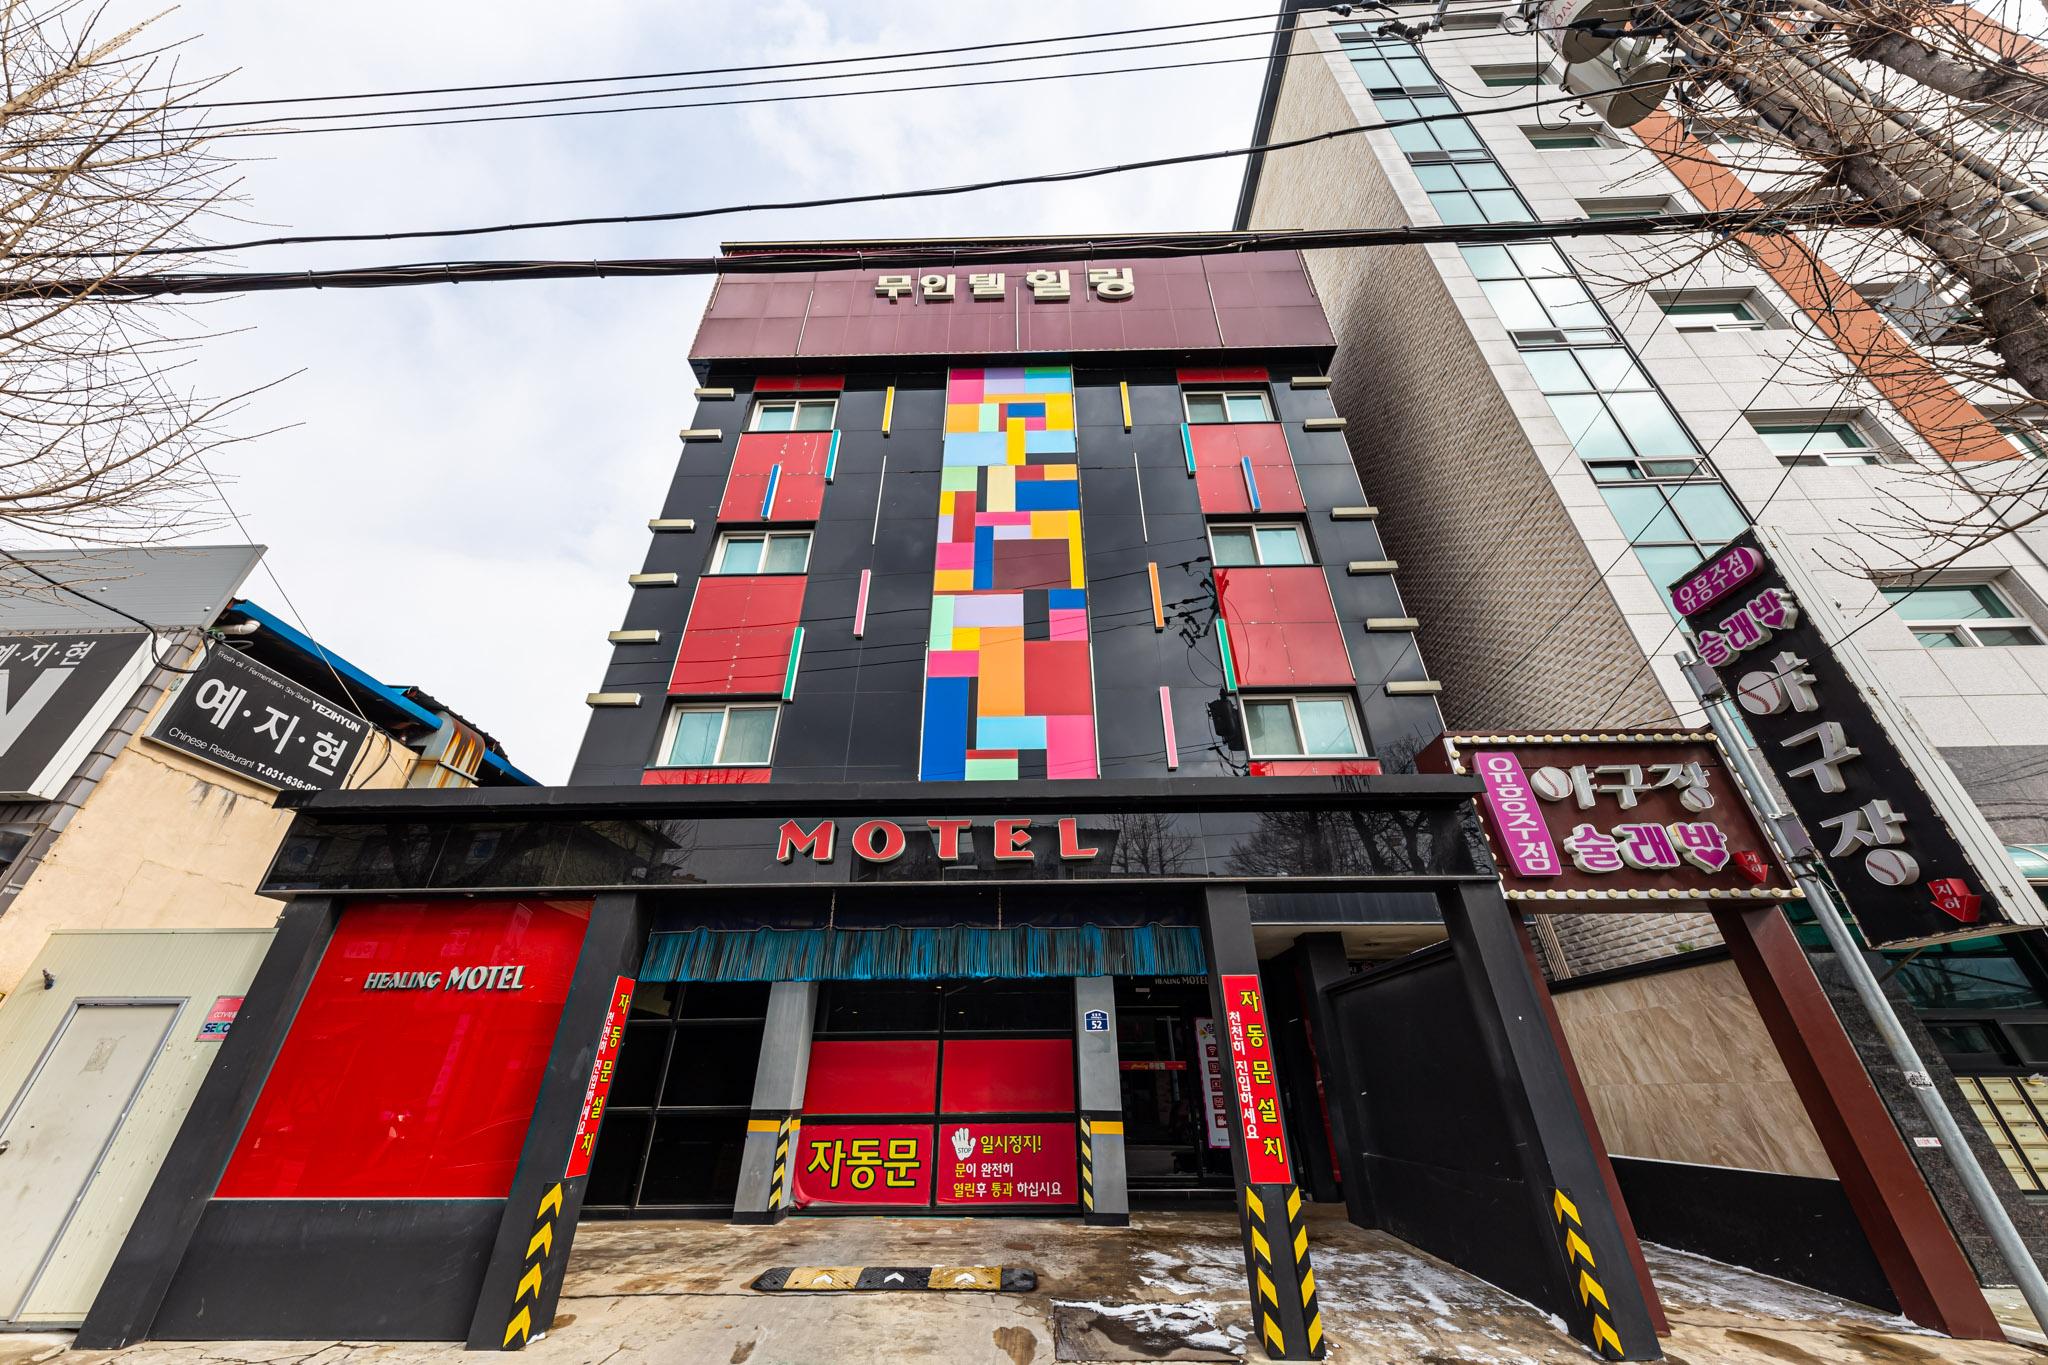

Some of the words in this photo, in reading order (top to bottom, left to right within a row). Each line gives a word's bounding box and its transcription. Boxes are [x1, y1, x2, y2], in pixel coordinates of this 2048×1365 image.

[875, 272, 1005, 304] 무인텔
[1025, 268, 1135, 303] 힐링
[1678, 547, 1746, 611] 유흥주점
[217, 650, 236, 664] Fresh
[248, 666, 284, 690] Fermentation
[311, 700, 361, 733] YEZIHYUN
[168, 727, 208, 749] Chinese
[208, 743, 255, 768] Restaurant
[1487, 757, 1552, 873] 유흥주점
[776, 817, 1099, 863] MOTEL
[1934, 882, 1963, 910] 지하
[363, 971, 442, 990] HEALING
[445, 965, 525, 990] MOTEL
[1091, 1020, 1103, 1029] 52
[1228, 1011, 1246, 1056] 천천히
[1235, 1060, 1260, 1139] 진입하세요
[806, 1138, 920, 1189] 자동문
[980, 1135, 1042, 1154] 일시정지!
[953, 1182, 987, 1198] 열린후
[991, 1182, 1013, 1198] 통과
[955, 1163, 977, 1178] 문이
[981, 1162, 1013, 1178] 완전히
